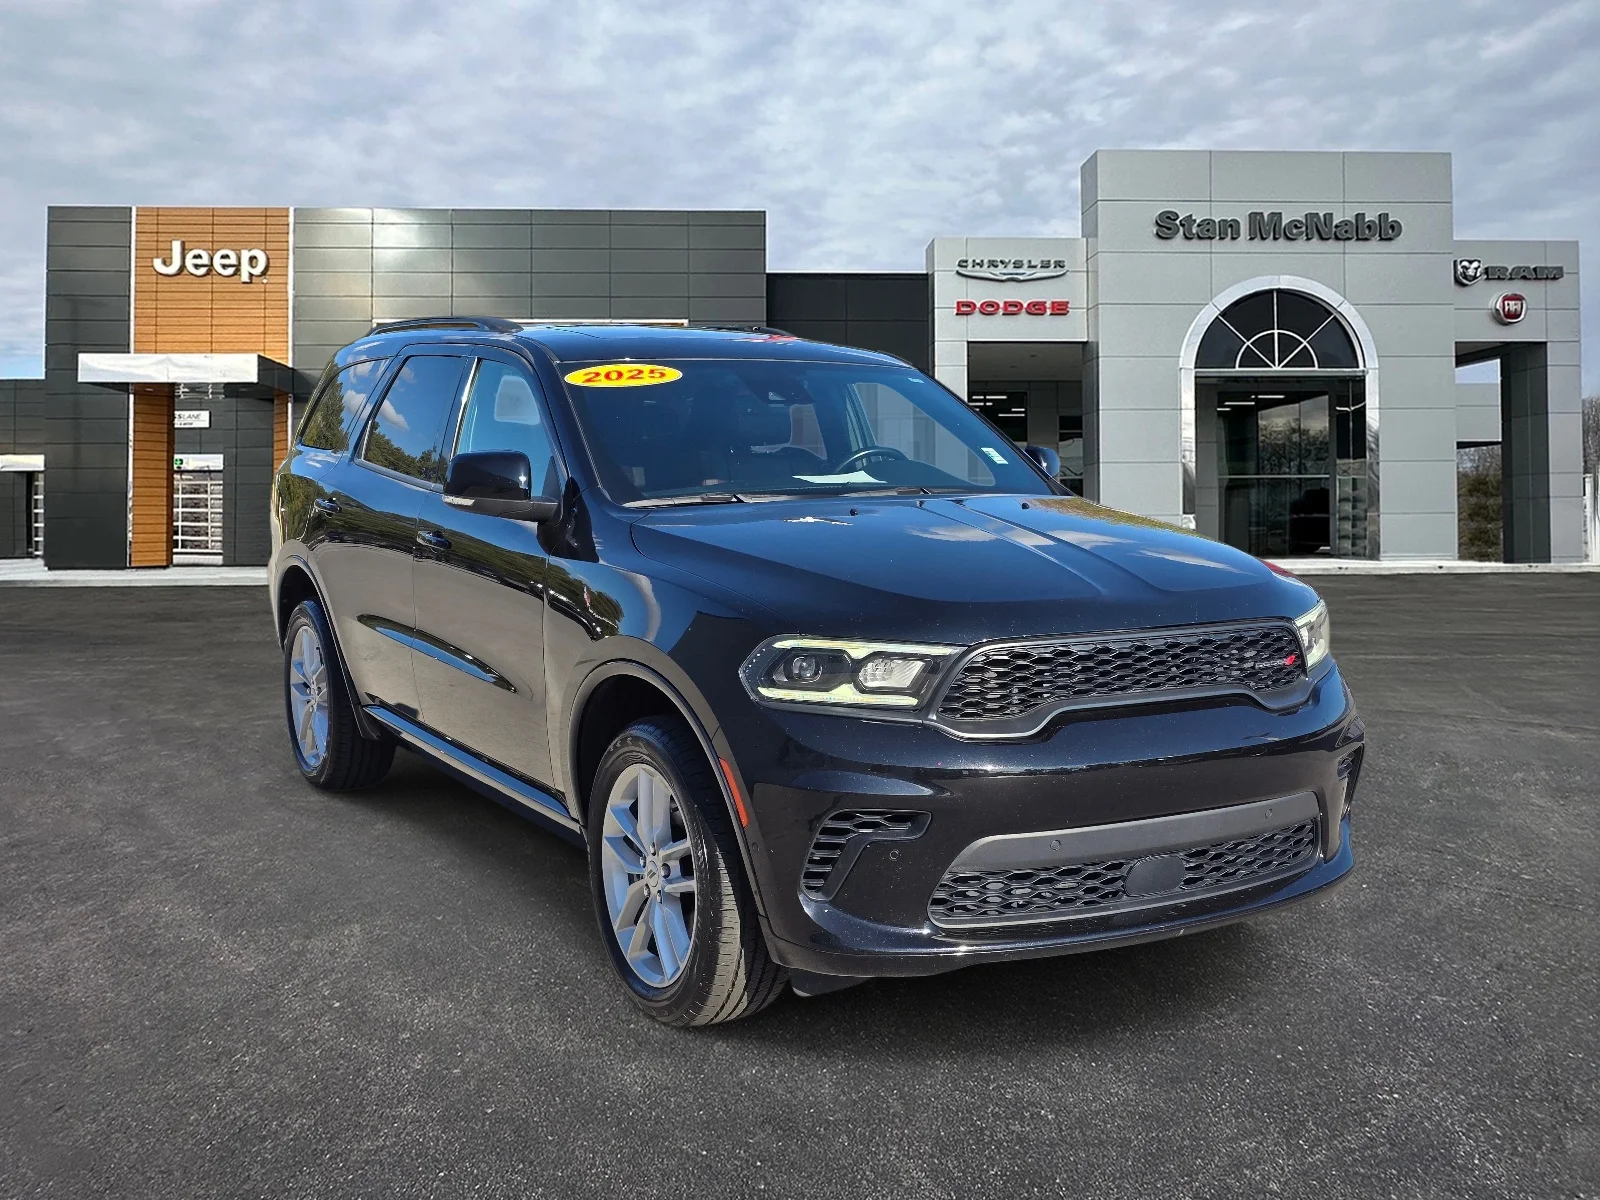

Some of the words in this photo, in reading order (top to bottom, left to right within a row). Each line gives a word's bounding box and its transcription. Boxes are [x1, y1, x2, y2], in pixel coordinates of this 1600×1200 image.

[1154, 209, 1241, 240] Stan
[1248, 211, 1402, 242] McNabb
[152, 239, 269, 284] Jeep
[957, 259, 1066, 269] CHRYSLER
[1484, 265, 1564, 280] RAM
[955, 300, 1070, 316] DODGE
[582, 368, 667, 383] 2025
